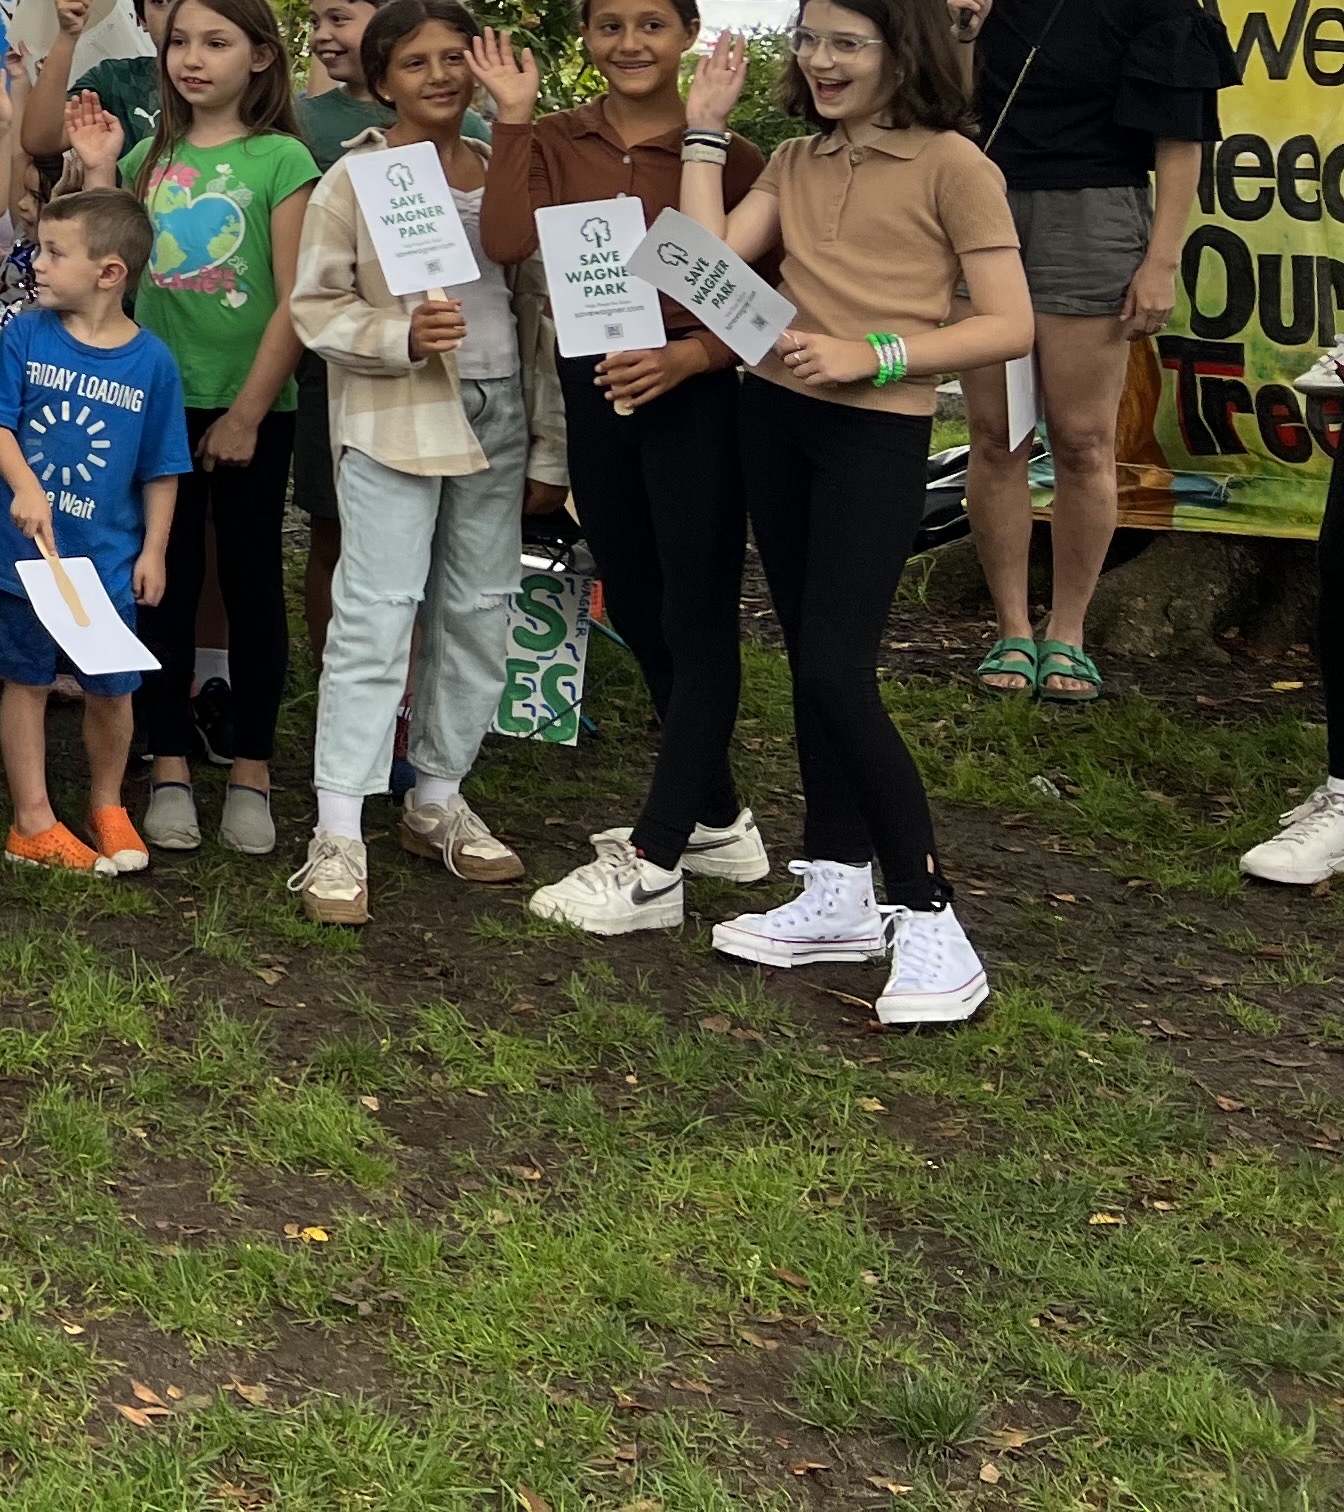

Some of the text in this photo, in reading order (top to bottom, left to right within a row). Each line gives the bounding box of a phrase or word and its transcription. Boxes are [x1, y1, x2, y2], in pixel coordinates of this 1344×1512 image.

[390, 193, 426, 210] SAVE
[380, 205, 445, 226] WAGNER
[399, 222, 438, 238] PARK
[580, 250, 620, 266] SAVE
[564, 266, 636, 284] WAGNE
[684, 257, 710, 286] SAVE
[690, 259, 730, 305] WAGNER
[584, 282, 628, 297] PARK
[711, 280, 737, 309] PARK
[77, 374, 145, 413] LOADING
[58, 491, 96, 520] Wait
[575, 578, 592, 638] WAGNER
